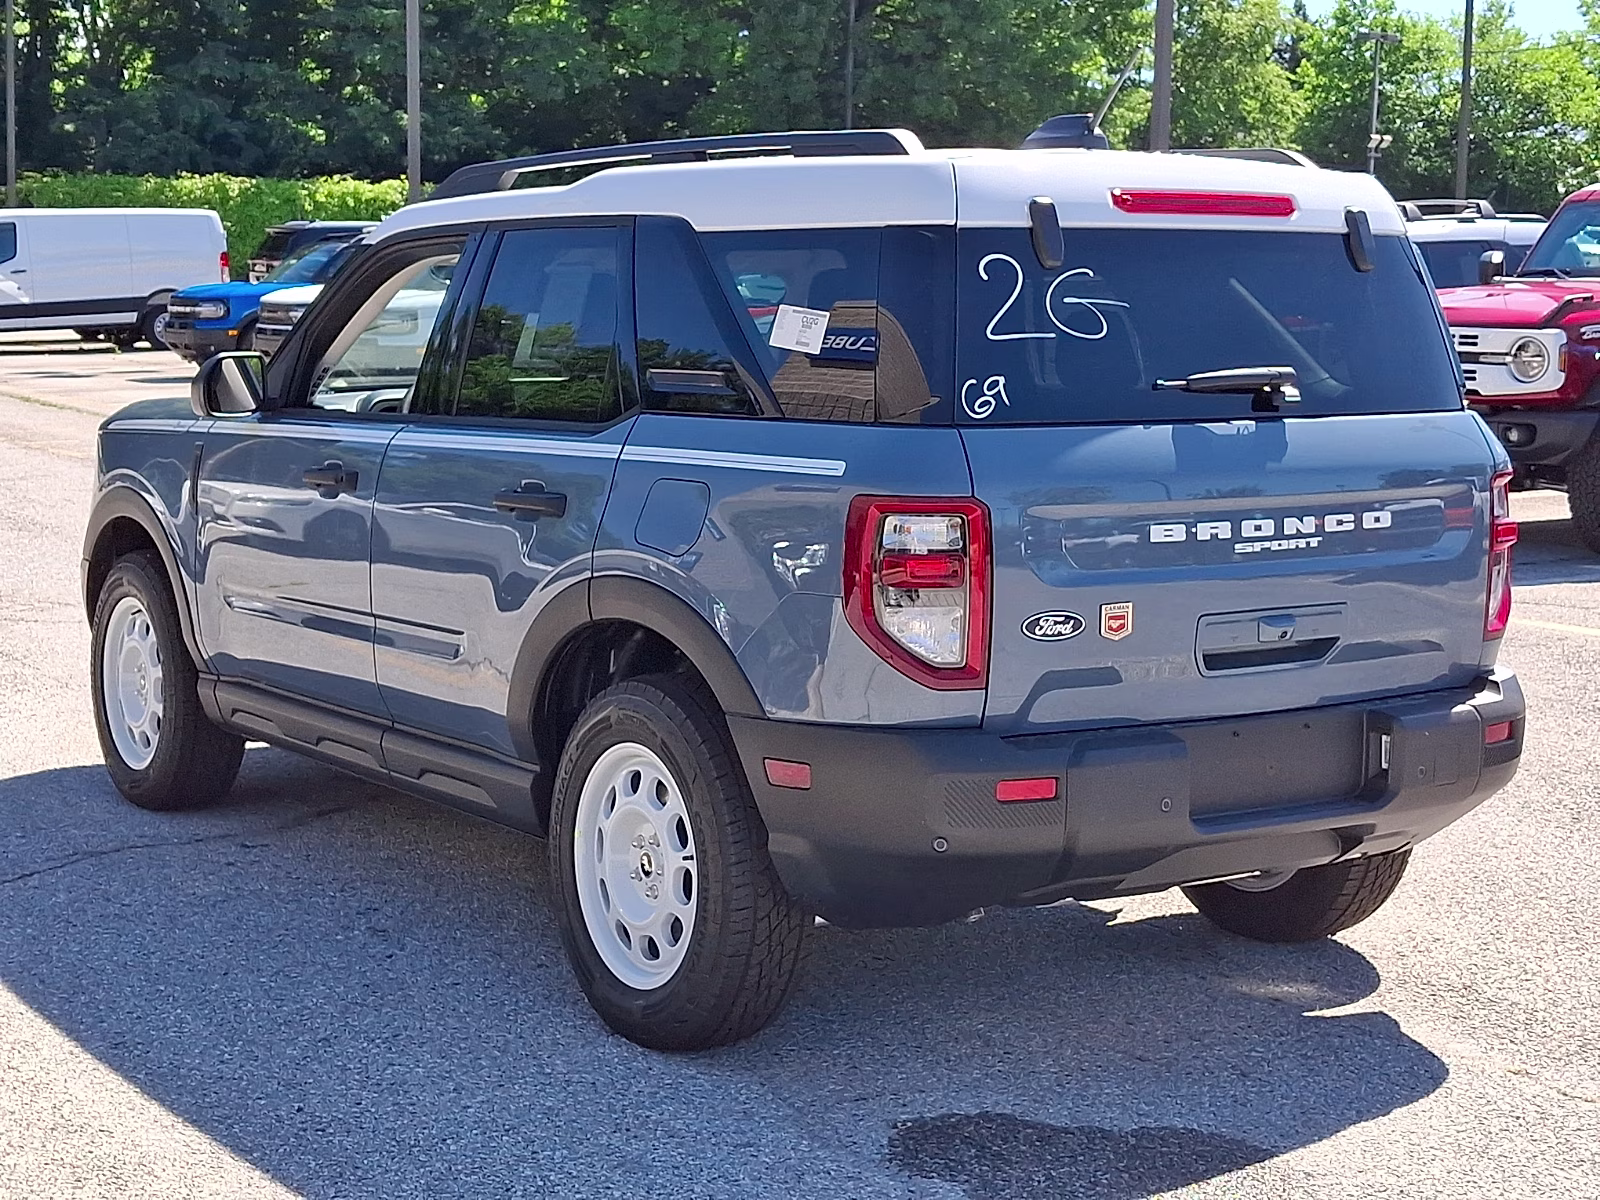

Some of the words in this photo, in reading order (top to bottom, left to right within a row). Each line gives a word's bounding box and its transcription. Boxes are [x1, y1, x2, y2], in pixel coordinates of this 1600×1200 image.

[978, 253, 1130, 340] 2G
[1149, 511, 1392, 543] BRONCO
[1234, 537, 1323, 553] SPORT
[1034, 616, 1075, 635] Ford
